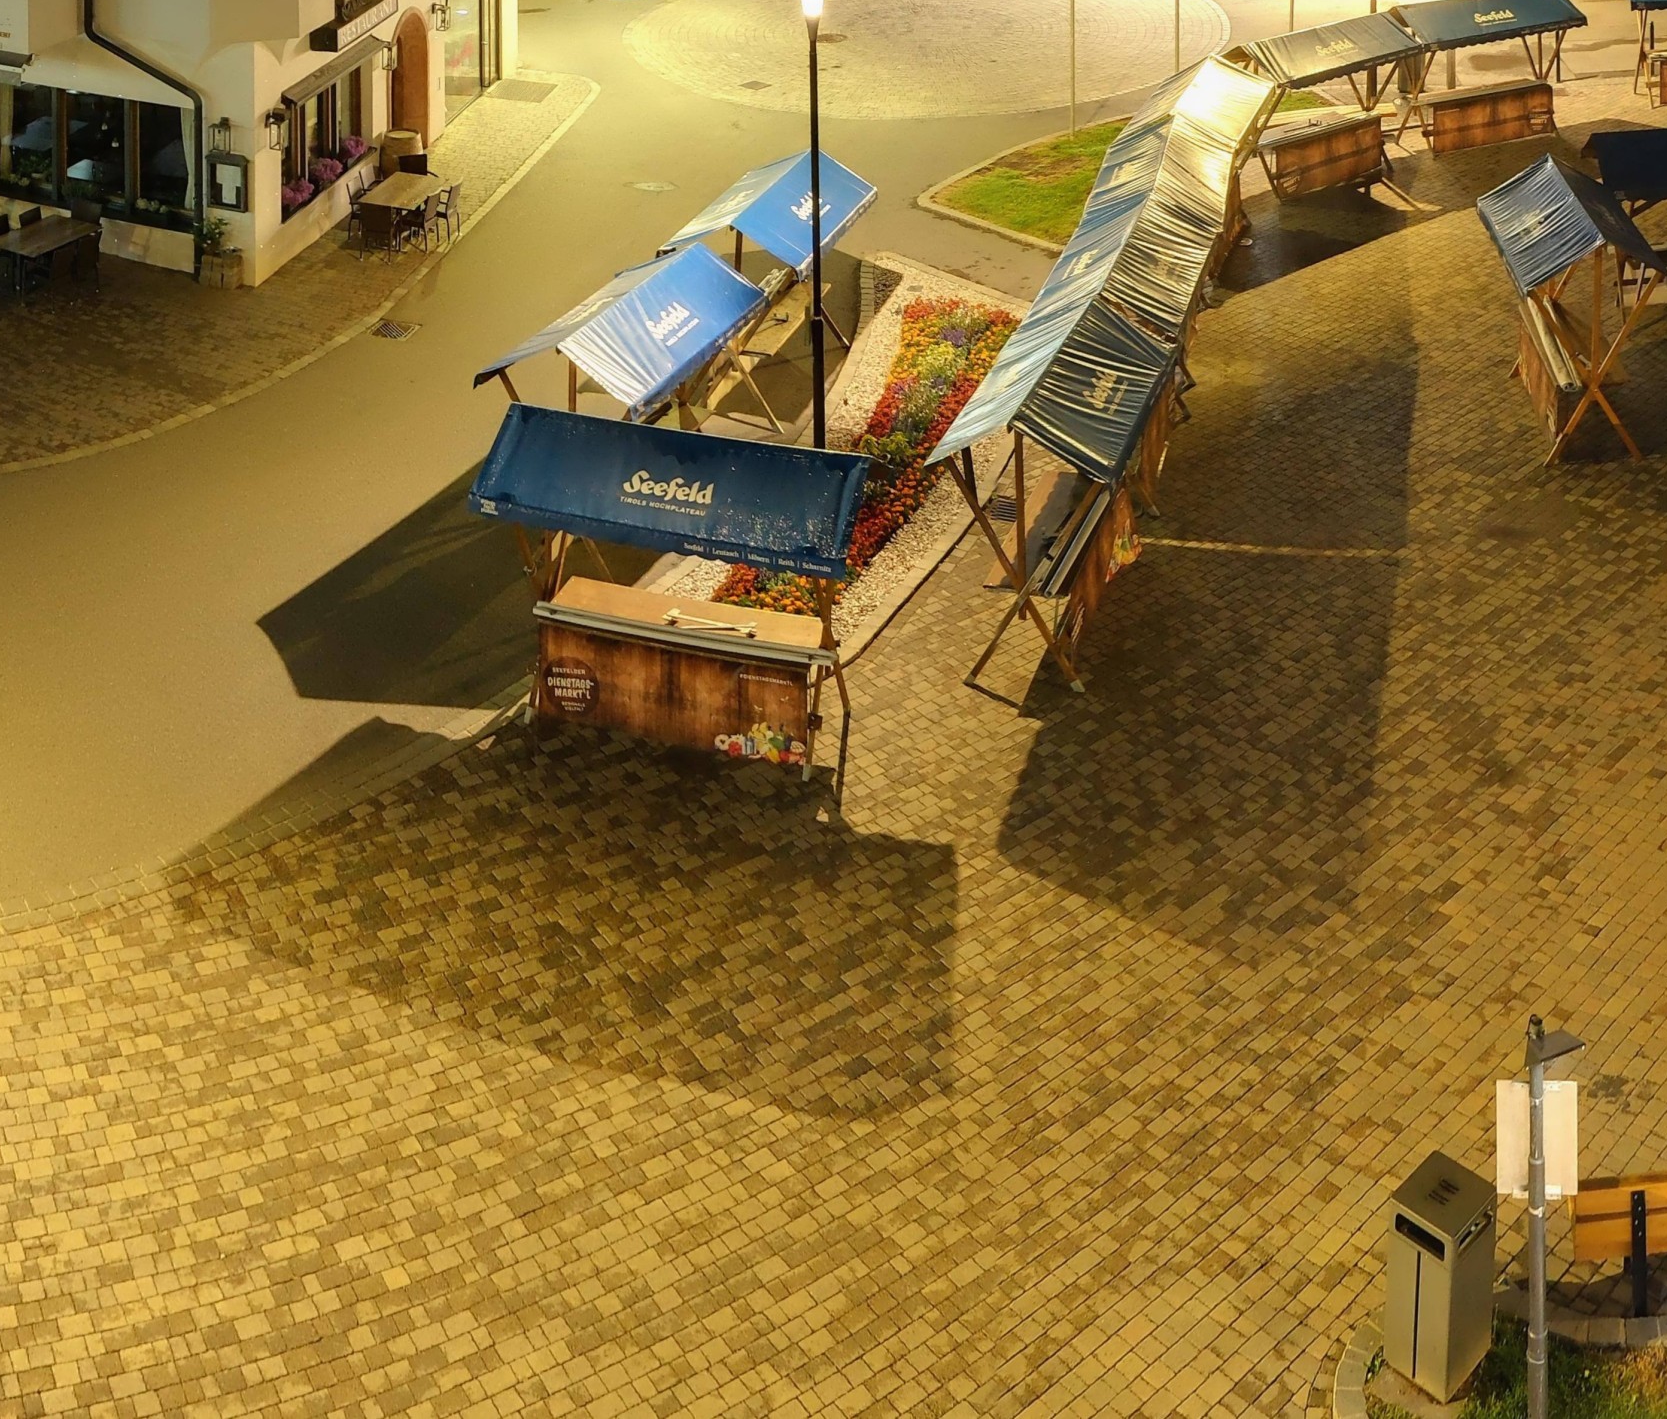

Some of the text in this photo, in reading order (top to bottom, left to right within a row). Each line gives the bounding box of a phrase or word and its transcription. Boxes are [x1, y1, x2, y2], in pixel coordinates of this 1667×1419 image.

[1473, 9, 1515, 25] Seefeld
[622, 469, 715, 506] Seefeld
[620, 495, 707, 517] TIROLS HOCHPLATEAU
